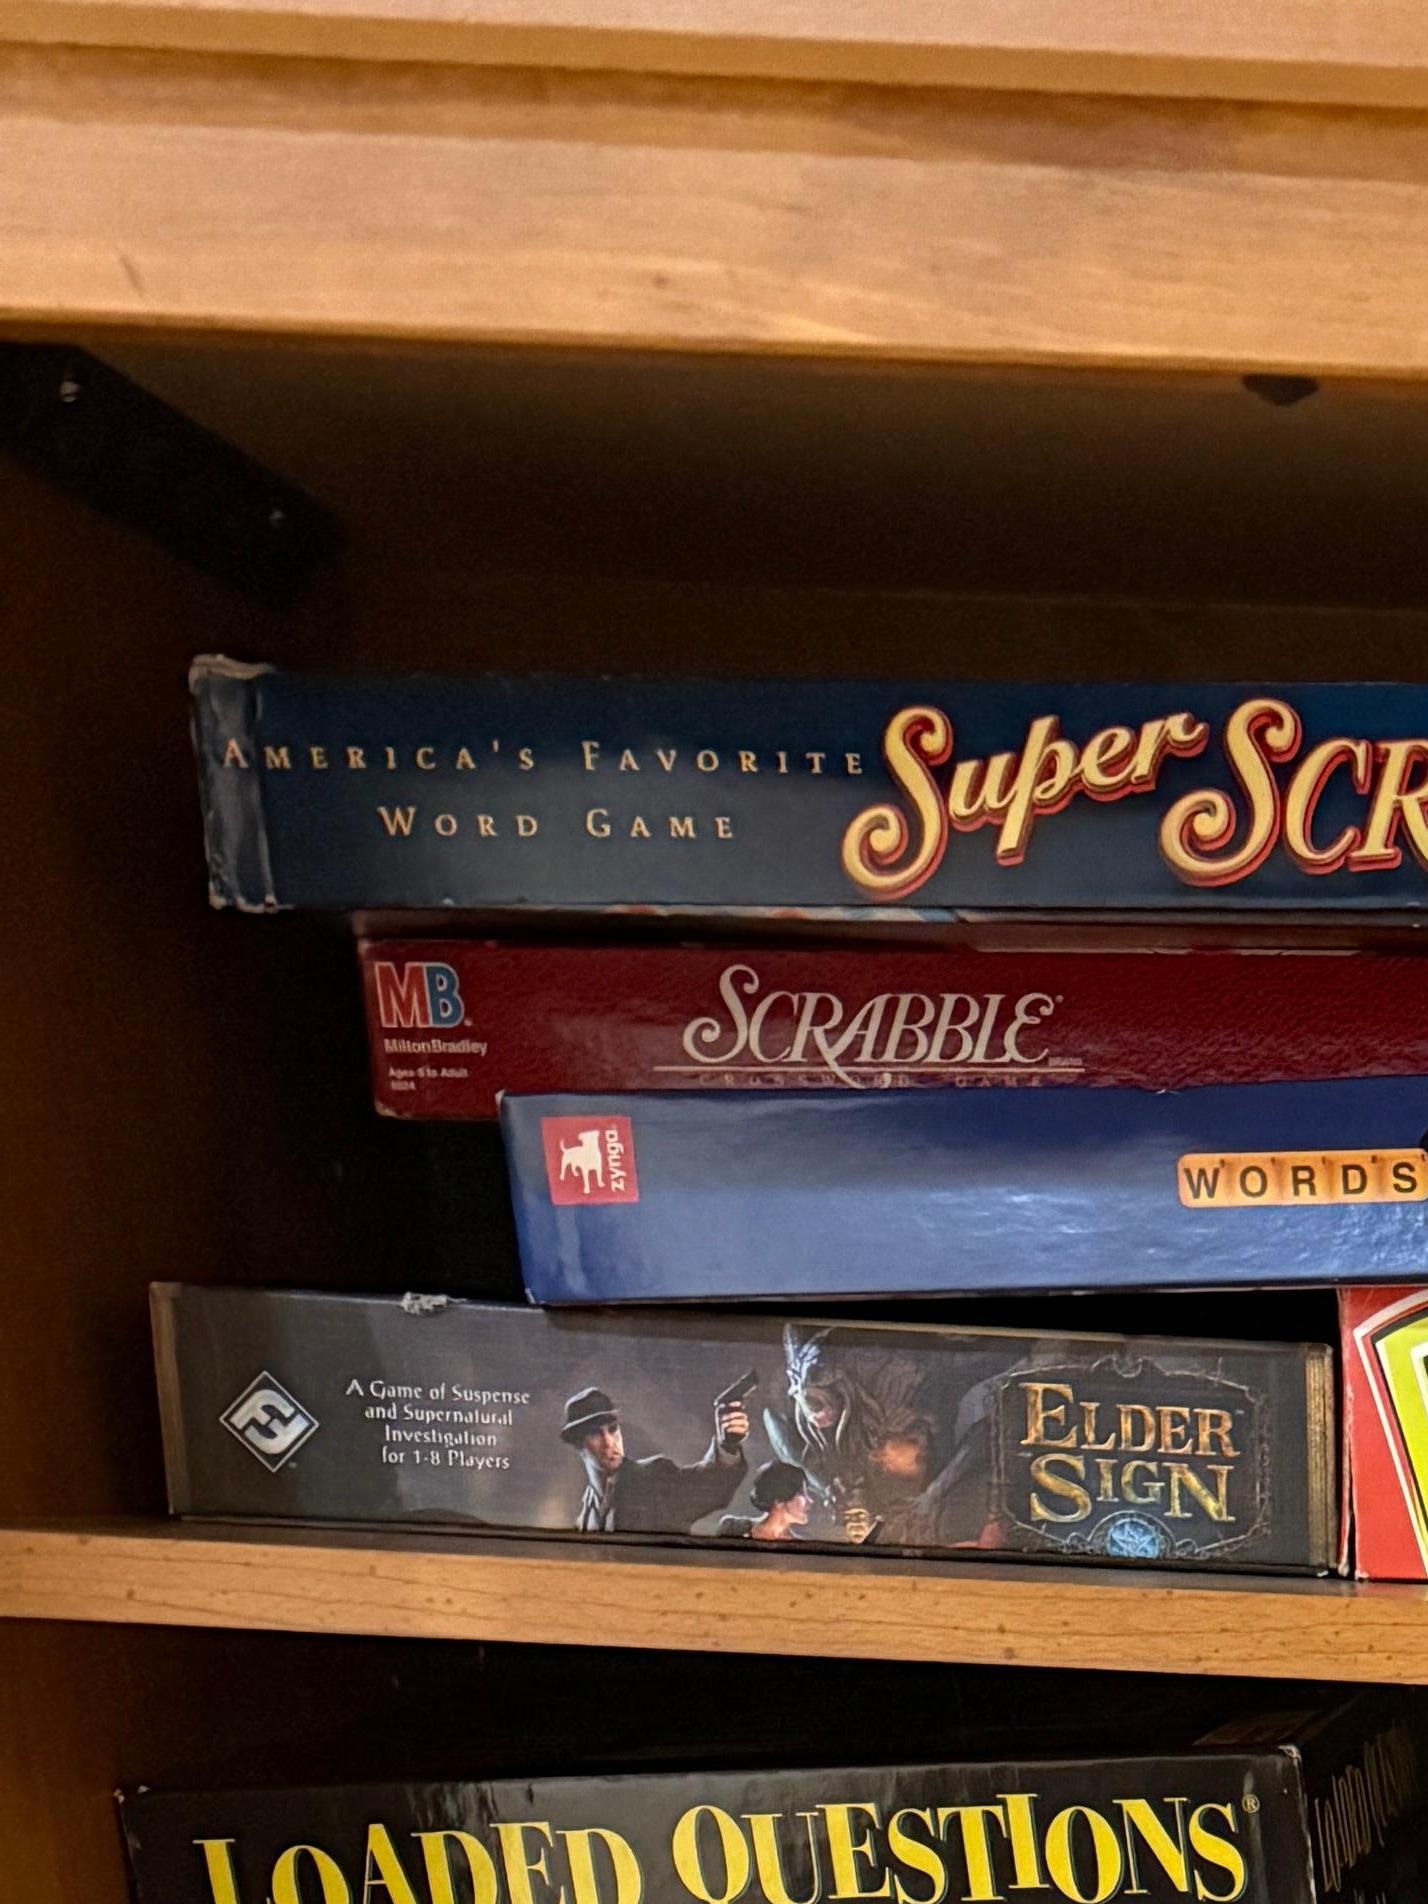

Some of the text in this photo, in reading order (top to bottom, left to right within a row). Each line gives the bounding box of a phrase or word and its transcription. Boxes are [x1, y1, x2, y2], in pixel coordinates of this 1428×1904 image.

[841, 703, 1208, 902] Super
[374, 961, 465, 1029] MB
[682, 964, 1056, 1087] SCRABBLE
[1184, 1161, 1416, 1198] WORDS
[365, 1404, 512, 1426] and Supernatural
[369, 1381, 422, 1400] Game
[430, 1383, 446, 1400] of
[452, 1385, 530, 1405] Suspense
[385, 1427, 496, 1447] Investigation
[1020, 1382, 1236, 1457] ELDER
[382, 1447, 510, 1471] for 1-8 Players
[1029, 1451, 1237, 1526] SIGN
